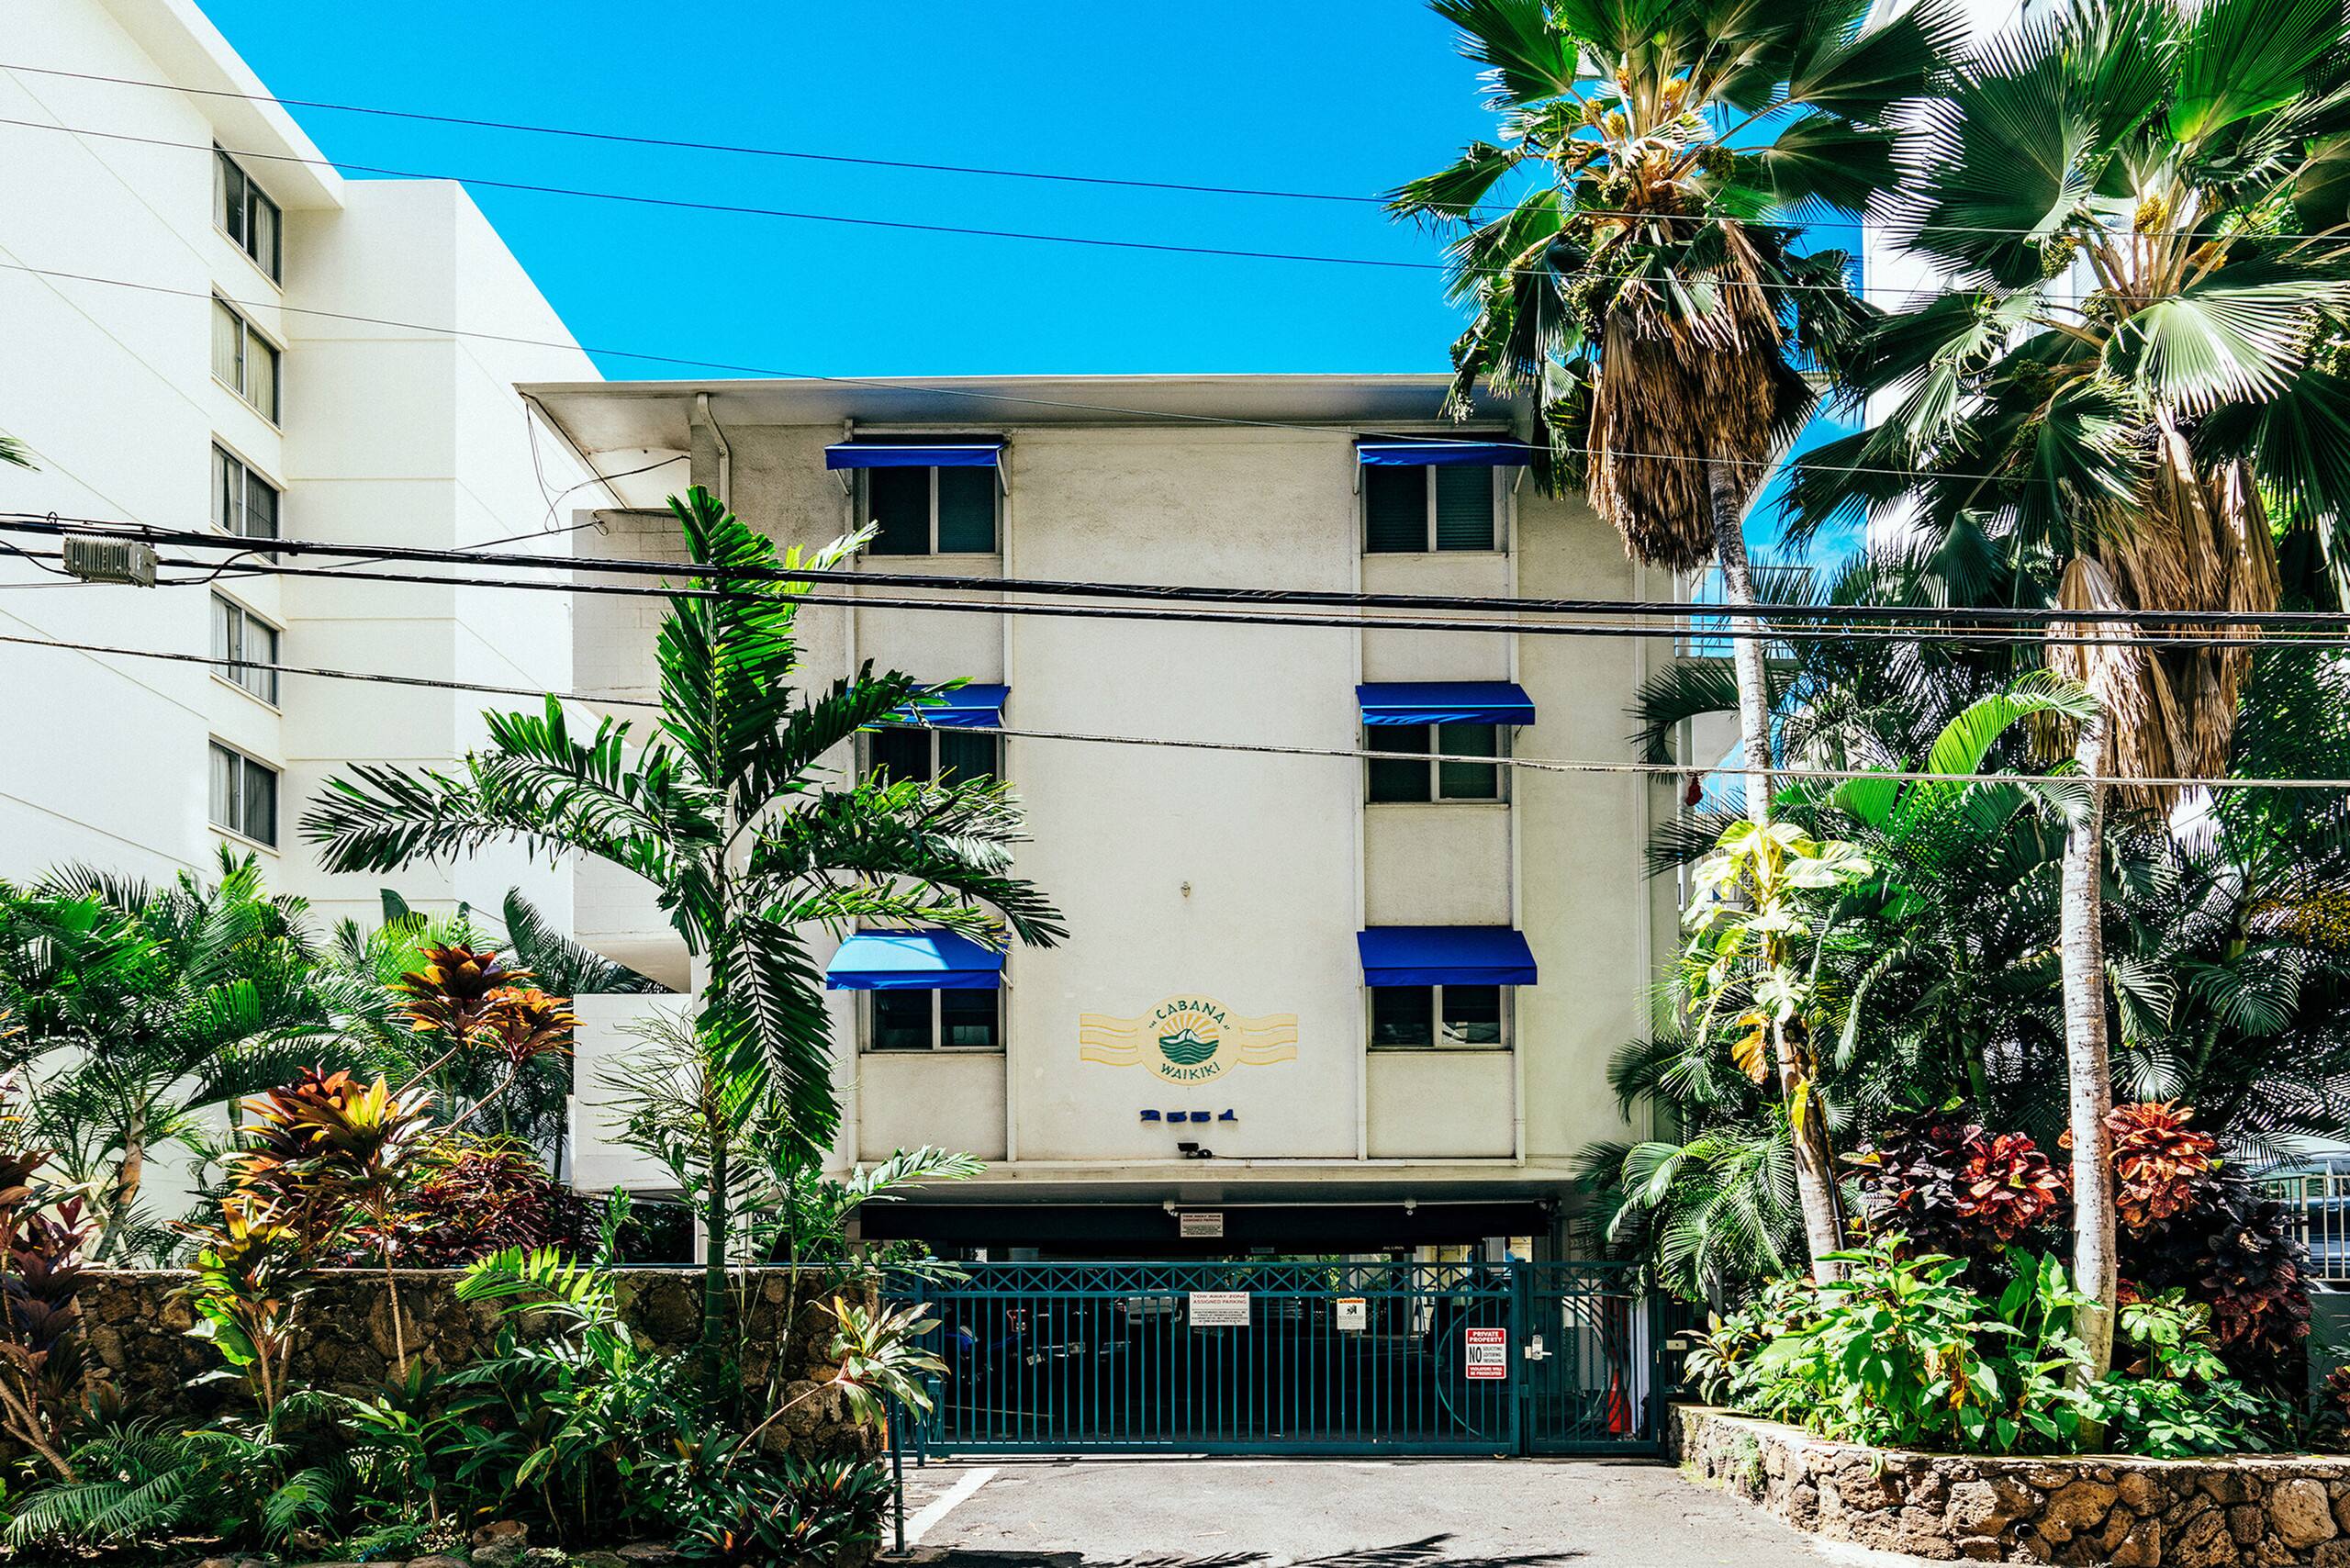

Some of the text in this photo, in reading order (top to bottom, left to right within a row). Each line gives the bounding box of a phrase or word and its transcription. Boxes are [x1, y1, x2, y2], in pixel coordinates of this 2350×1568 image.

[1156, 1000, 1225, 1025] CABANA
[1160, 1061, 1221, 1081] WAIKIKI
[1140, 1109, 1238, 1123] 2551
[1469, 1346, 1482, 1362] NO
